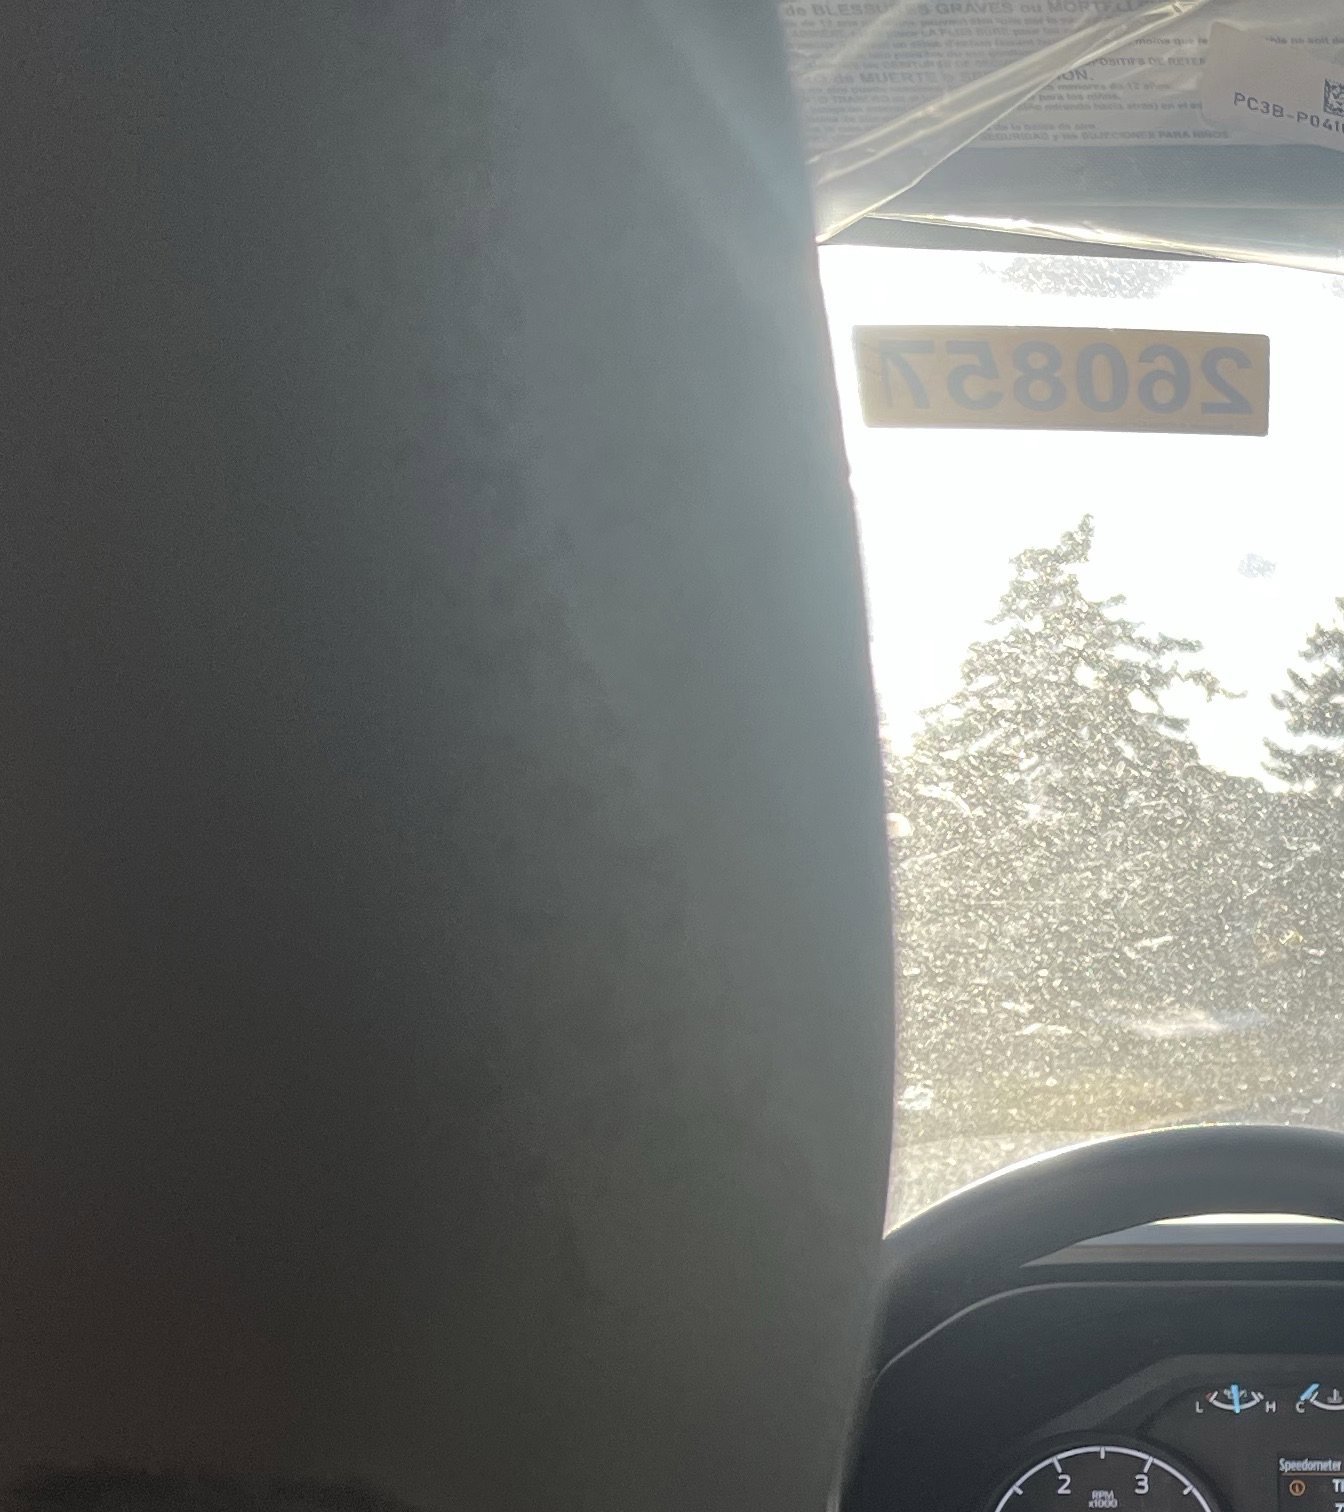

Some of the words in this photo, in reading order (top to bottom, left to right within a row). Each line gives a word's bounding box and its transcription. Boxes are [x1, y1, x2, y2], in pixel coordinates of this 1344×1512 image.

[811, 2, 930, 16] BLESSUS
[935, 1, 1012, 14] GRAVES
[1020, 3, 1041, 13] ou
[1195, 1401, 1203, 1414] L
[1265, 1401, 1277, 1413] H
[1296, 1401, 1305, 1414] C
[1279, 1457, 1342, 1473] Speedometer
[1057, 1474, 1072, 1495] 2
[1134, 1474, 1149, 1495] 3
[1091, 1490, 1115, 1500] RPM
[1088, 1499, 1118, 1509] x1000
